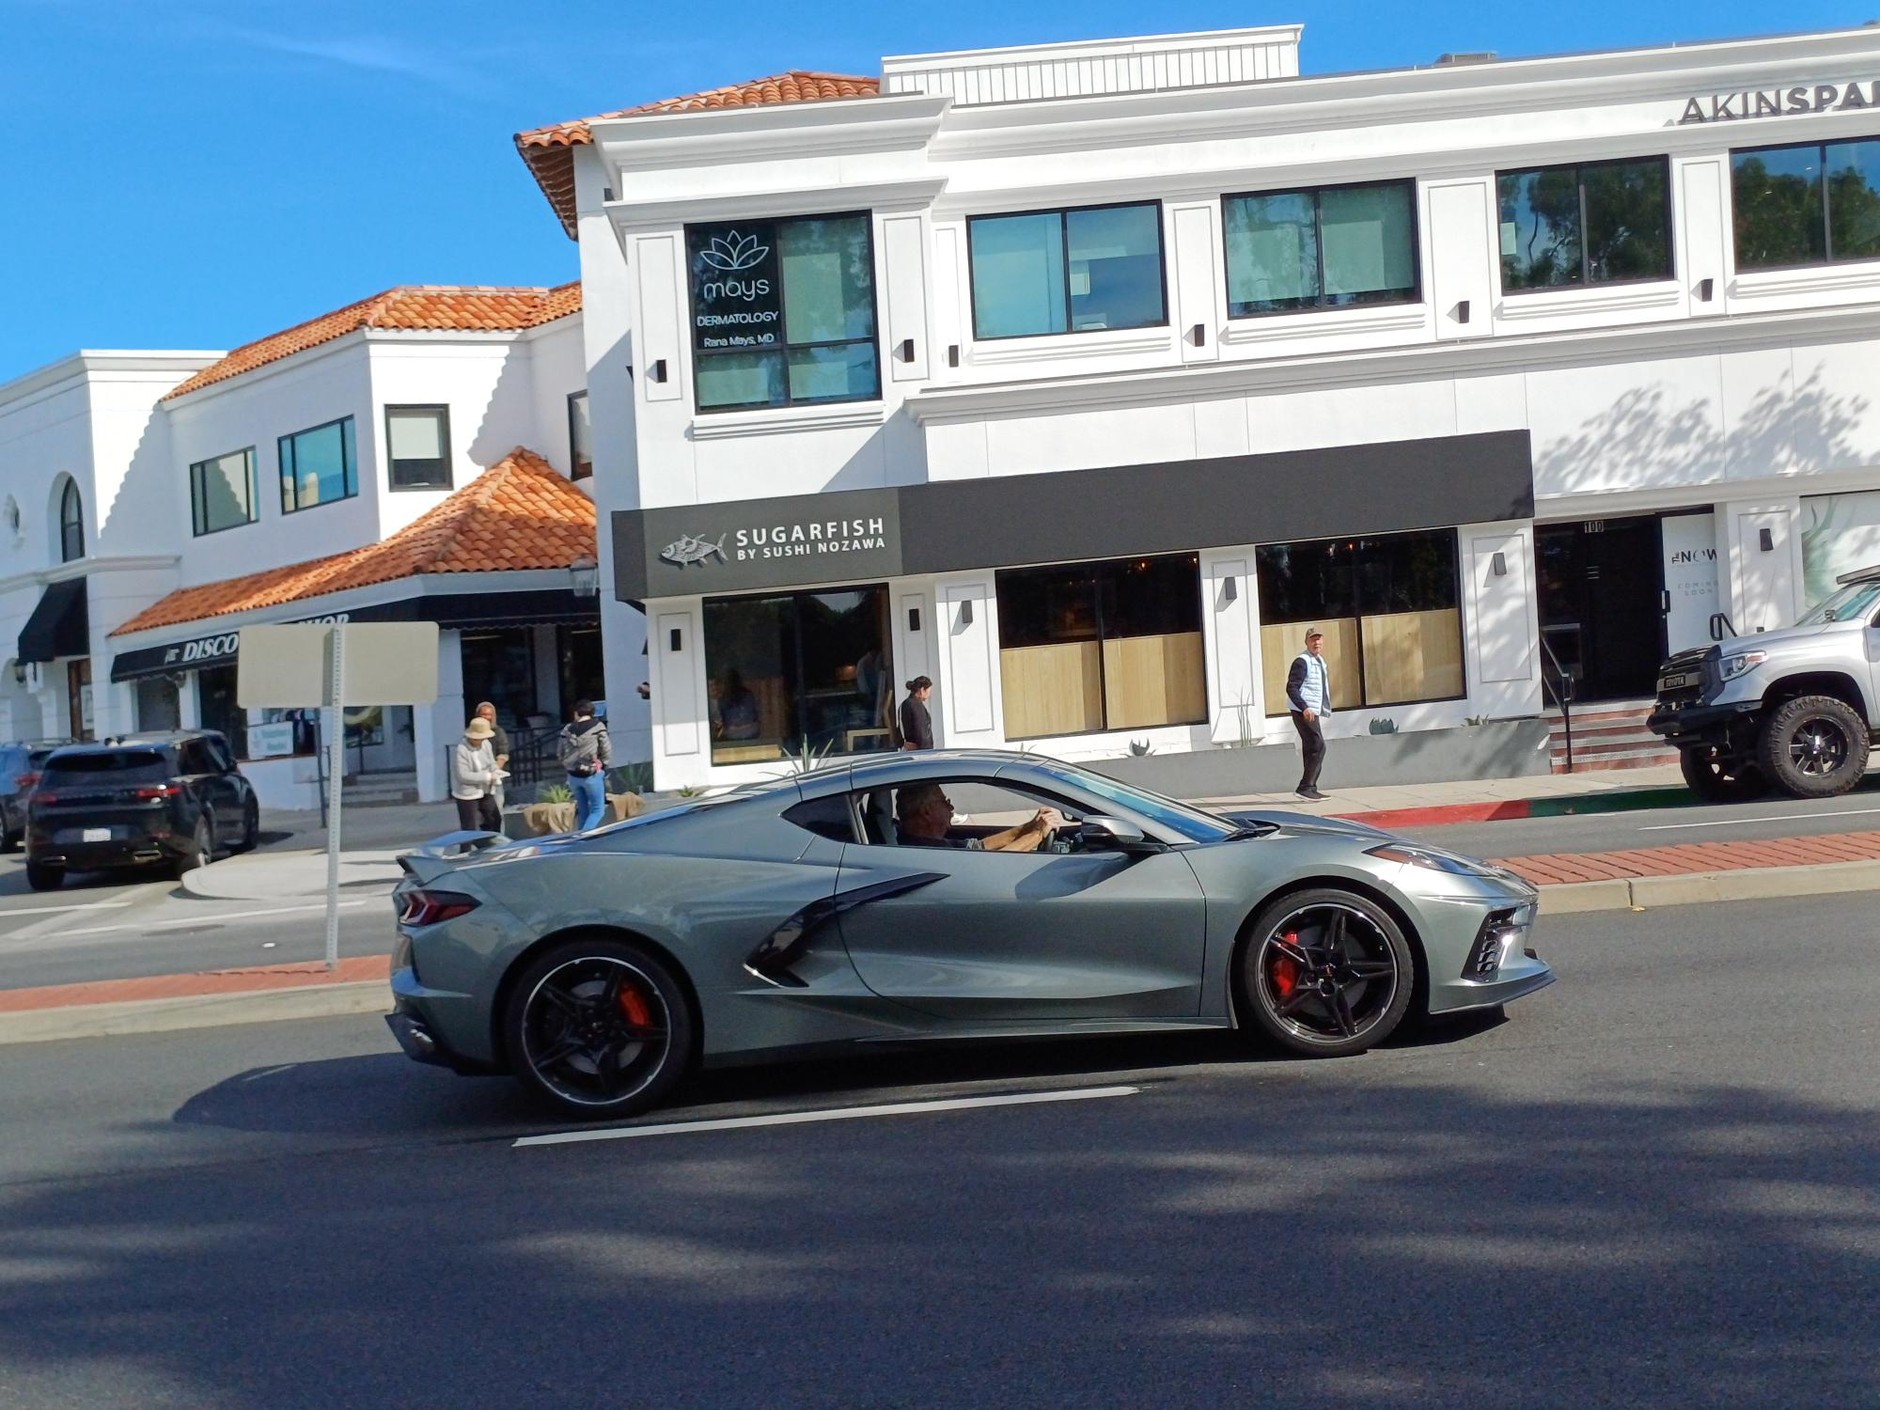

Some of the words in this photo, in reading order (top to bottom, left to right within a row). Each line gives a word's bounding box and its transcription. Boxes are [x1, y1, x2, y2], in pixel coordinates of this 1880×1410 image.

[1680, 80, 1880, 125] AKINSPA
[703, 279, 770, 302] mays
[697, 311, 779, 327] DERMATOLOGY
[704, 336, 728, 348] Rana
[758, 333, 775, 343] MD
[736, 517, 884, 547] SUGARFISH
[1584, 521, 1604, 533] 100
[737, 549, 756, 561] BY
[763, 544, 811, 559] SUSHI
[818, 537, 885, 553] NOZAWA
